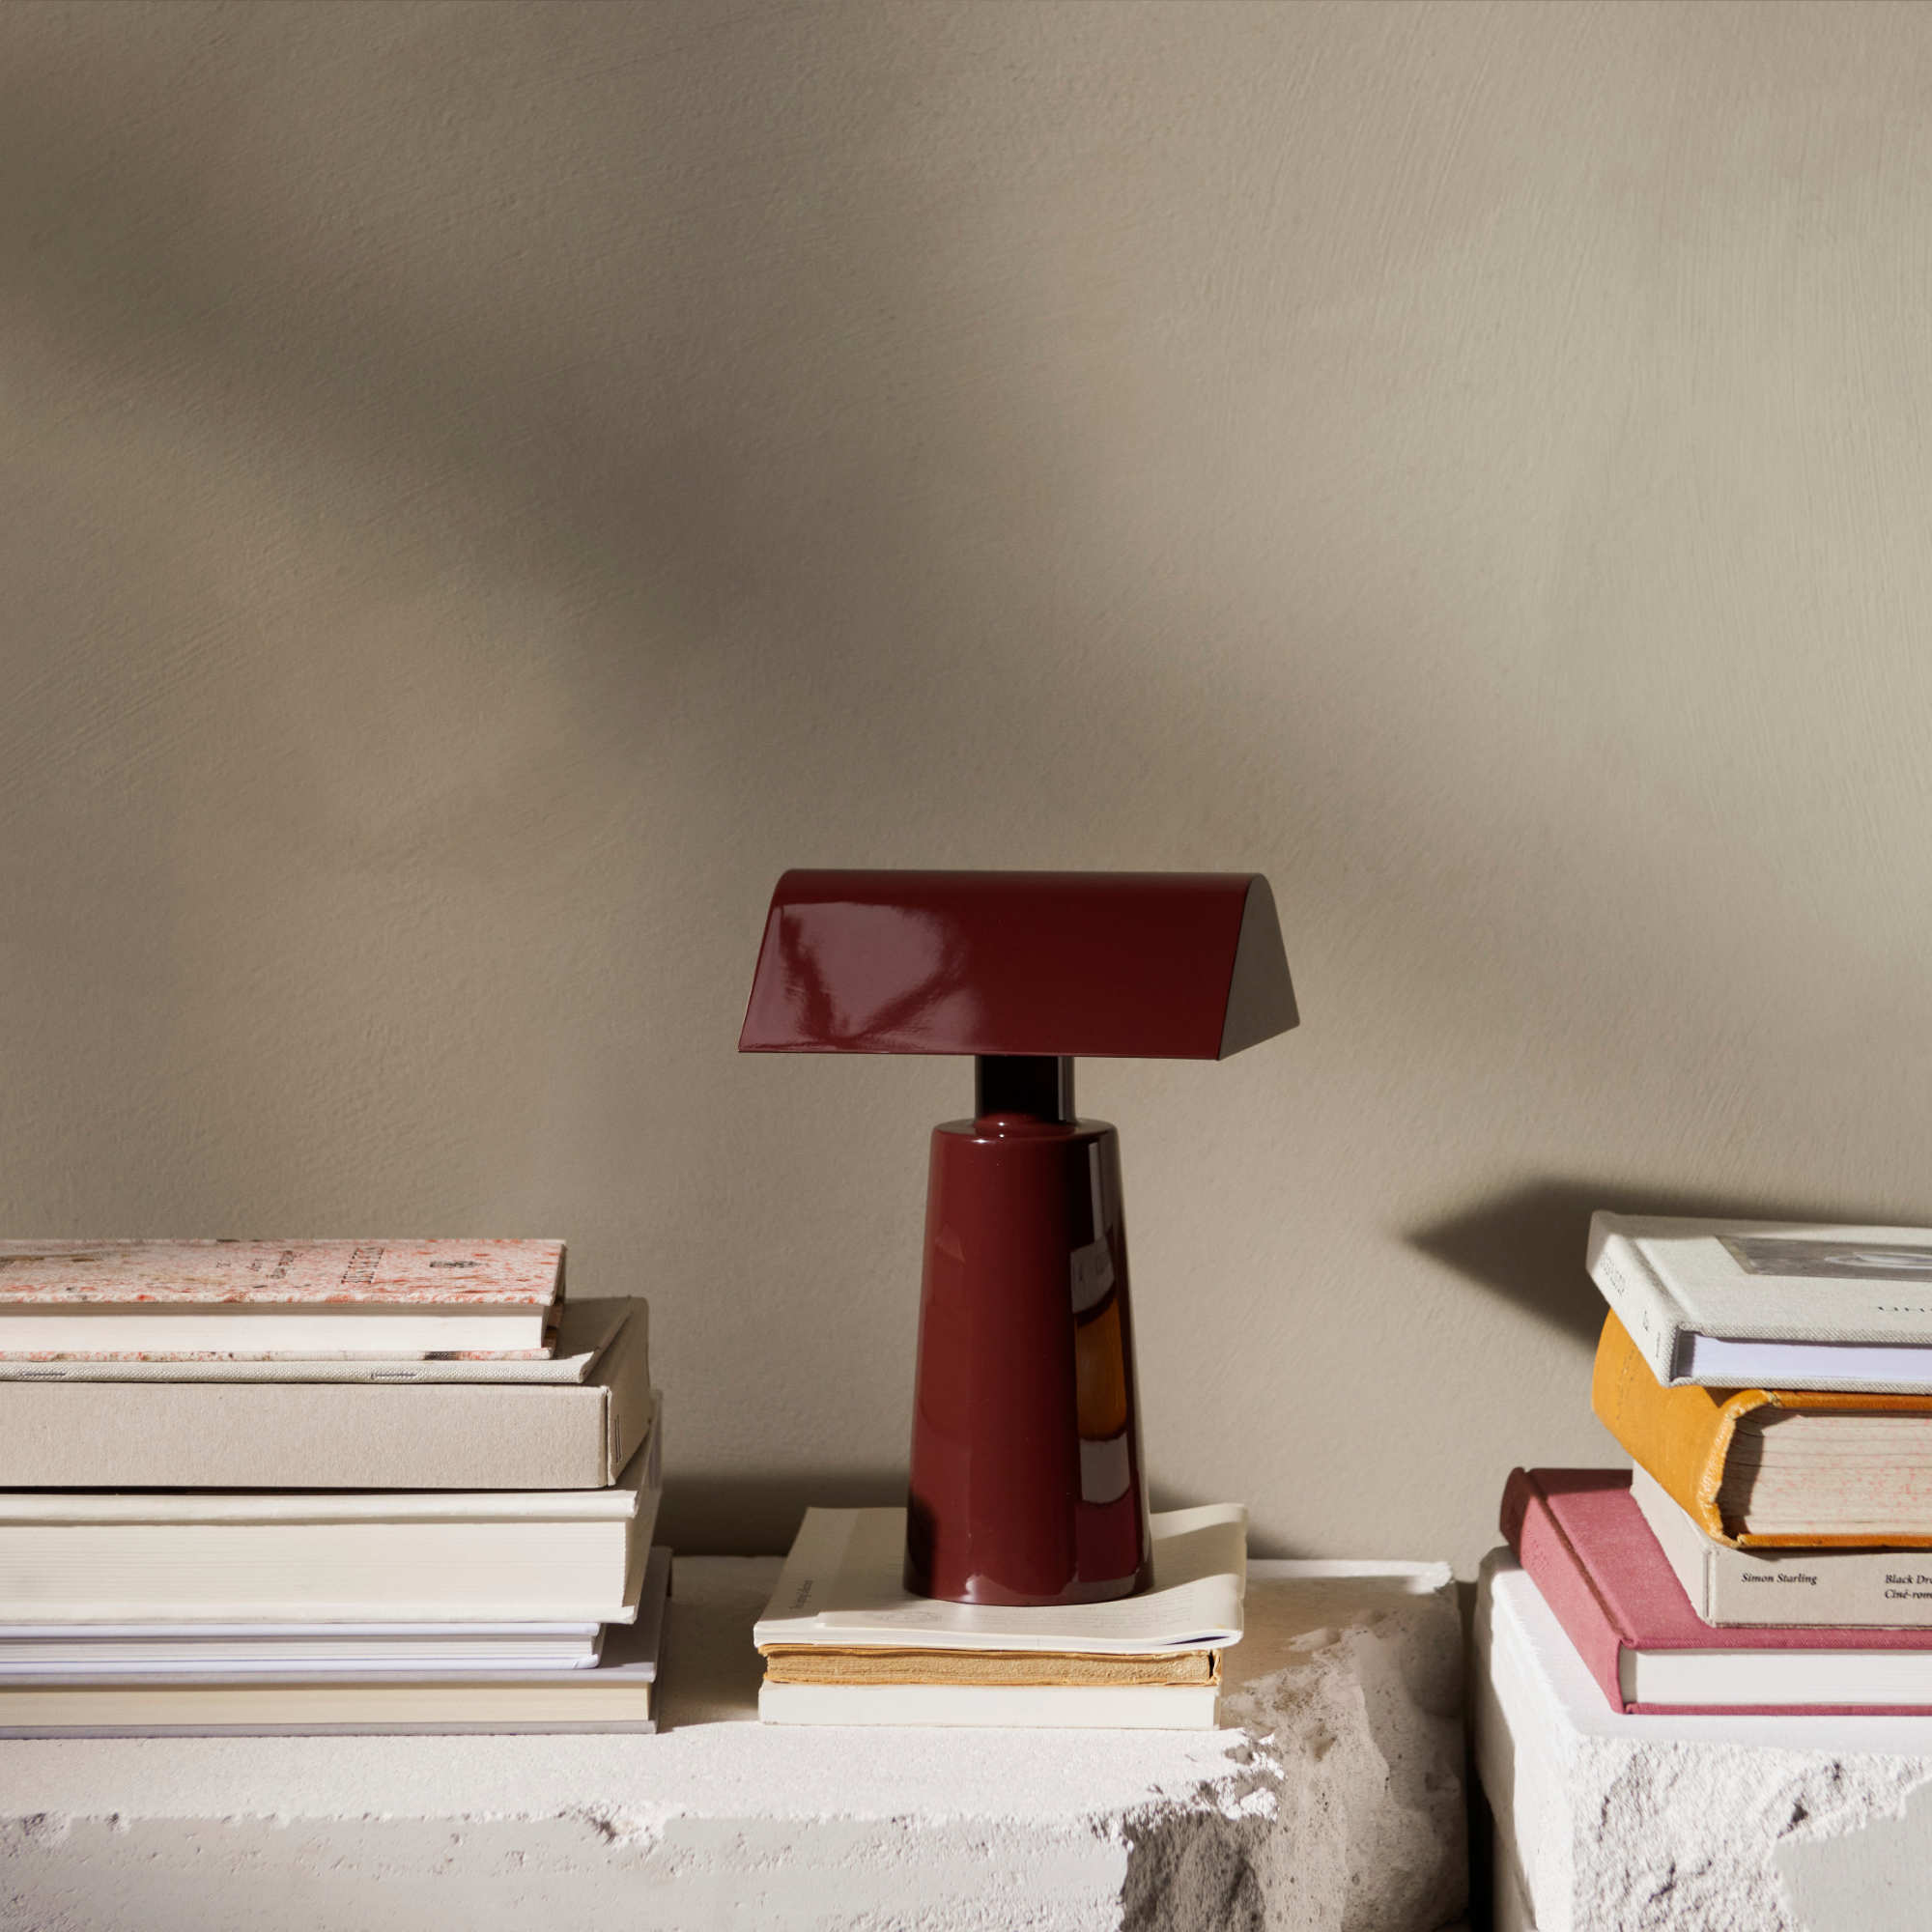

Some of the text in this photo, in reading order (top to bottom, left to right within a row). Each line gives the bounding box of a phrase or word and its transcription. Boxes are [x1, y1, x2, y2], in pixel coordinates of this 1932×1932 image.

[1742, 1573, 1817, 1585] Simon Starling
[1885, 1574, 1914, 1584] Black
